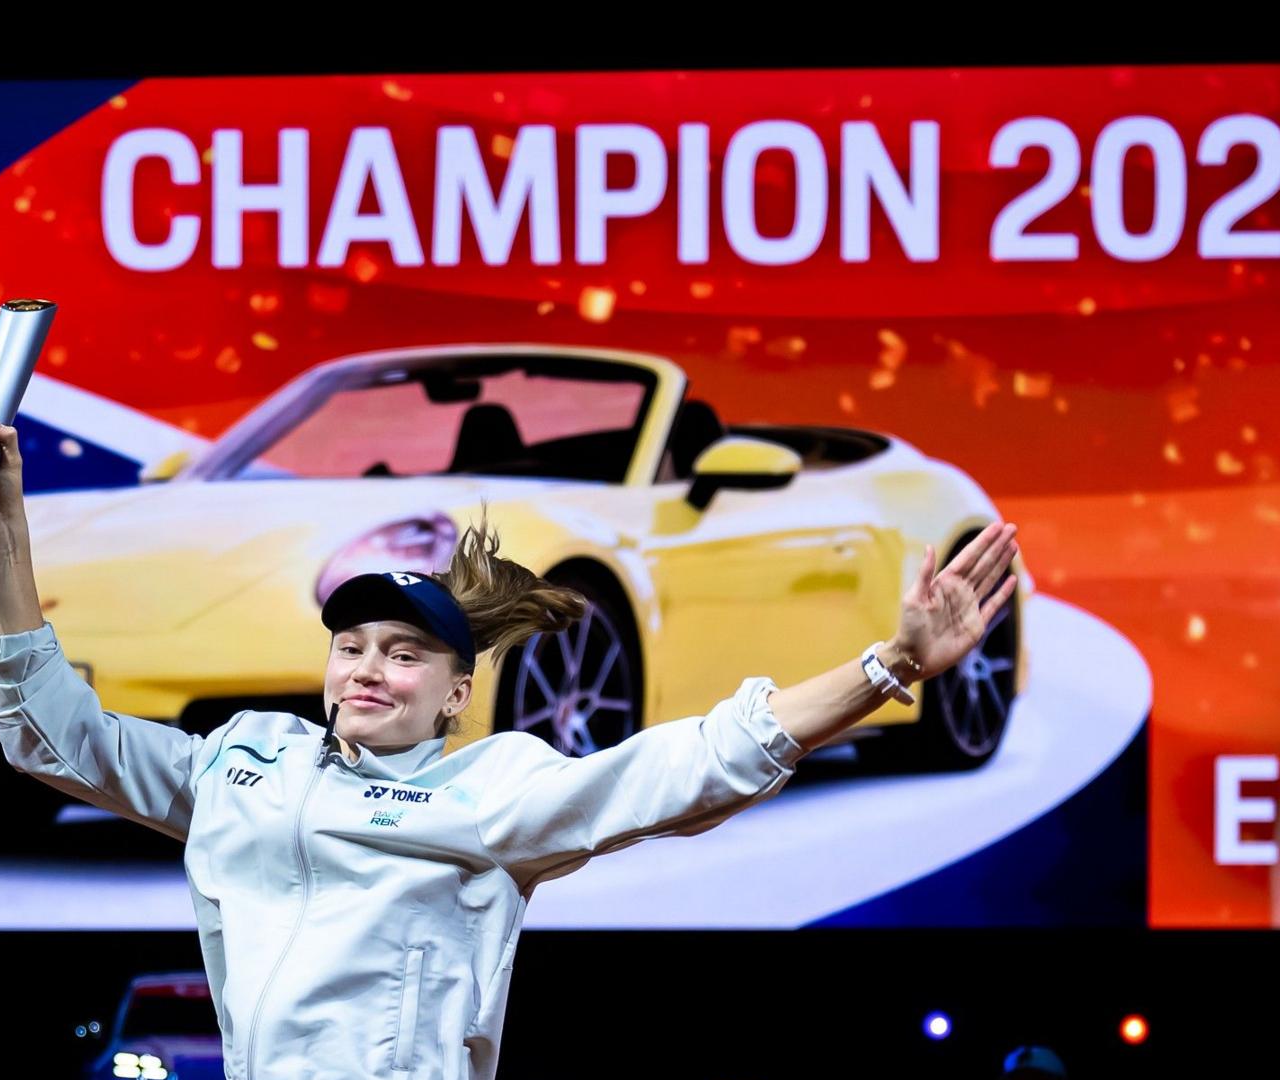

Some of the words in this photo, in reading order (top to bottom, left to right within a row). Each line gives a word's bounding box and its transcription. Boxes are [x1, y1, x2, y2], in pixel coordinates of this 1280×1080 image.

[102, 121, 940, 272] CHAMPION
[391, 785, 433, 803] YONEX
[370, 817, 400, 828] RBK
